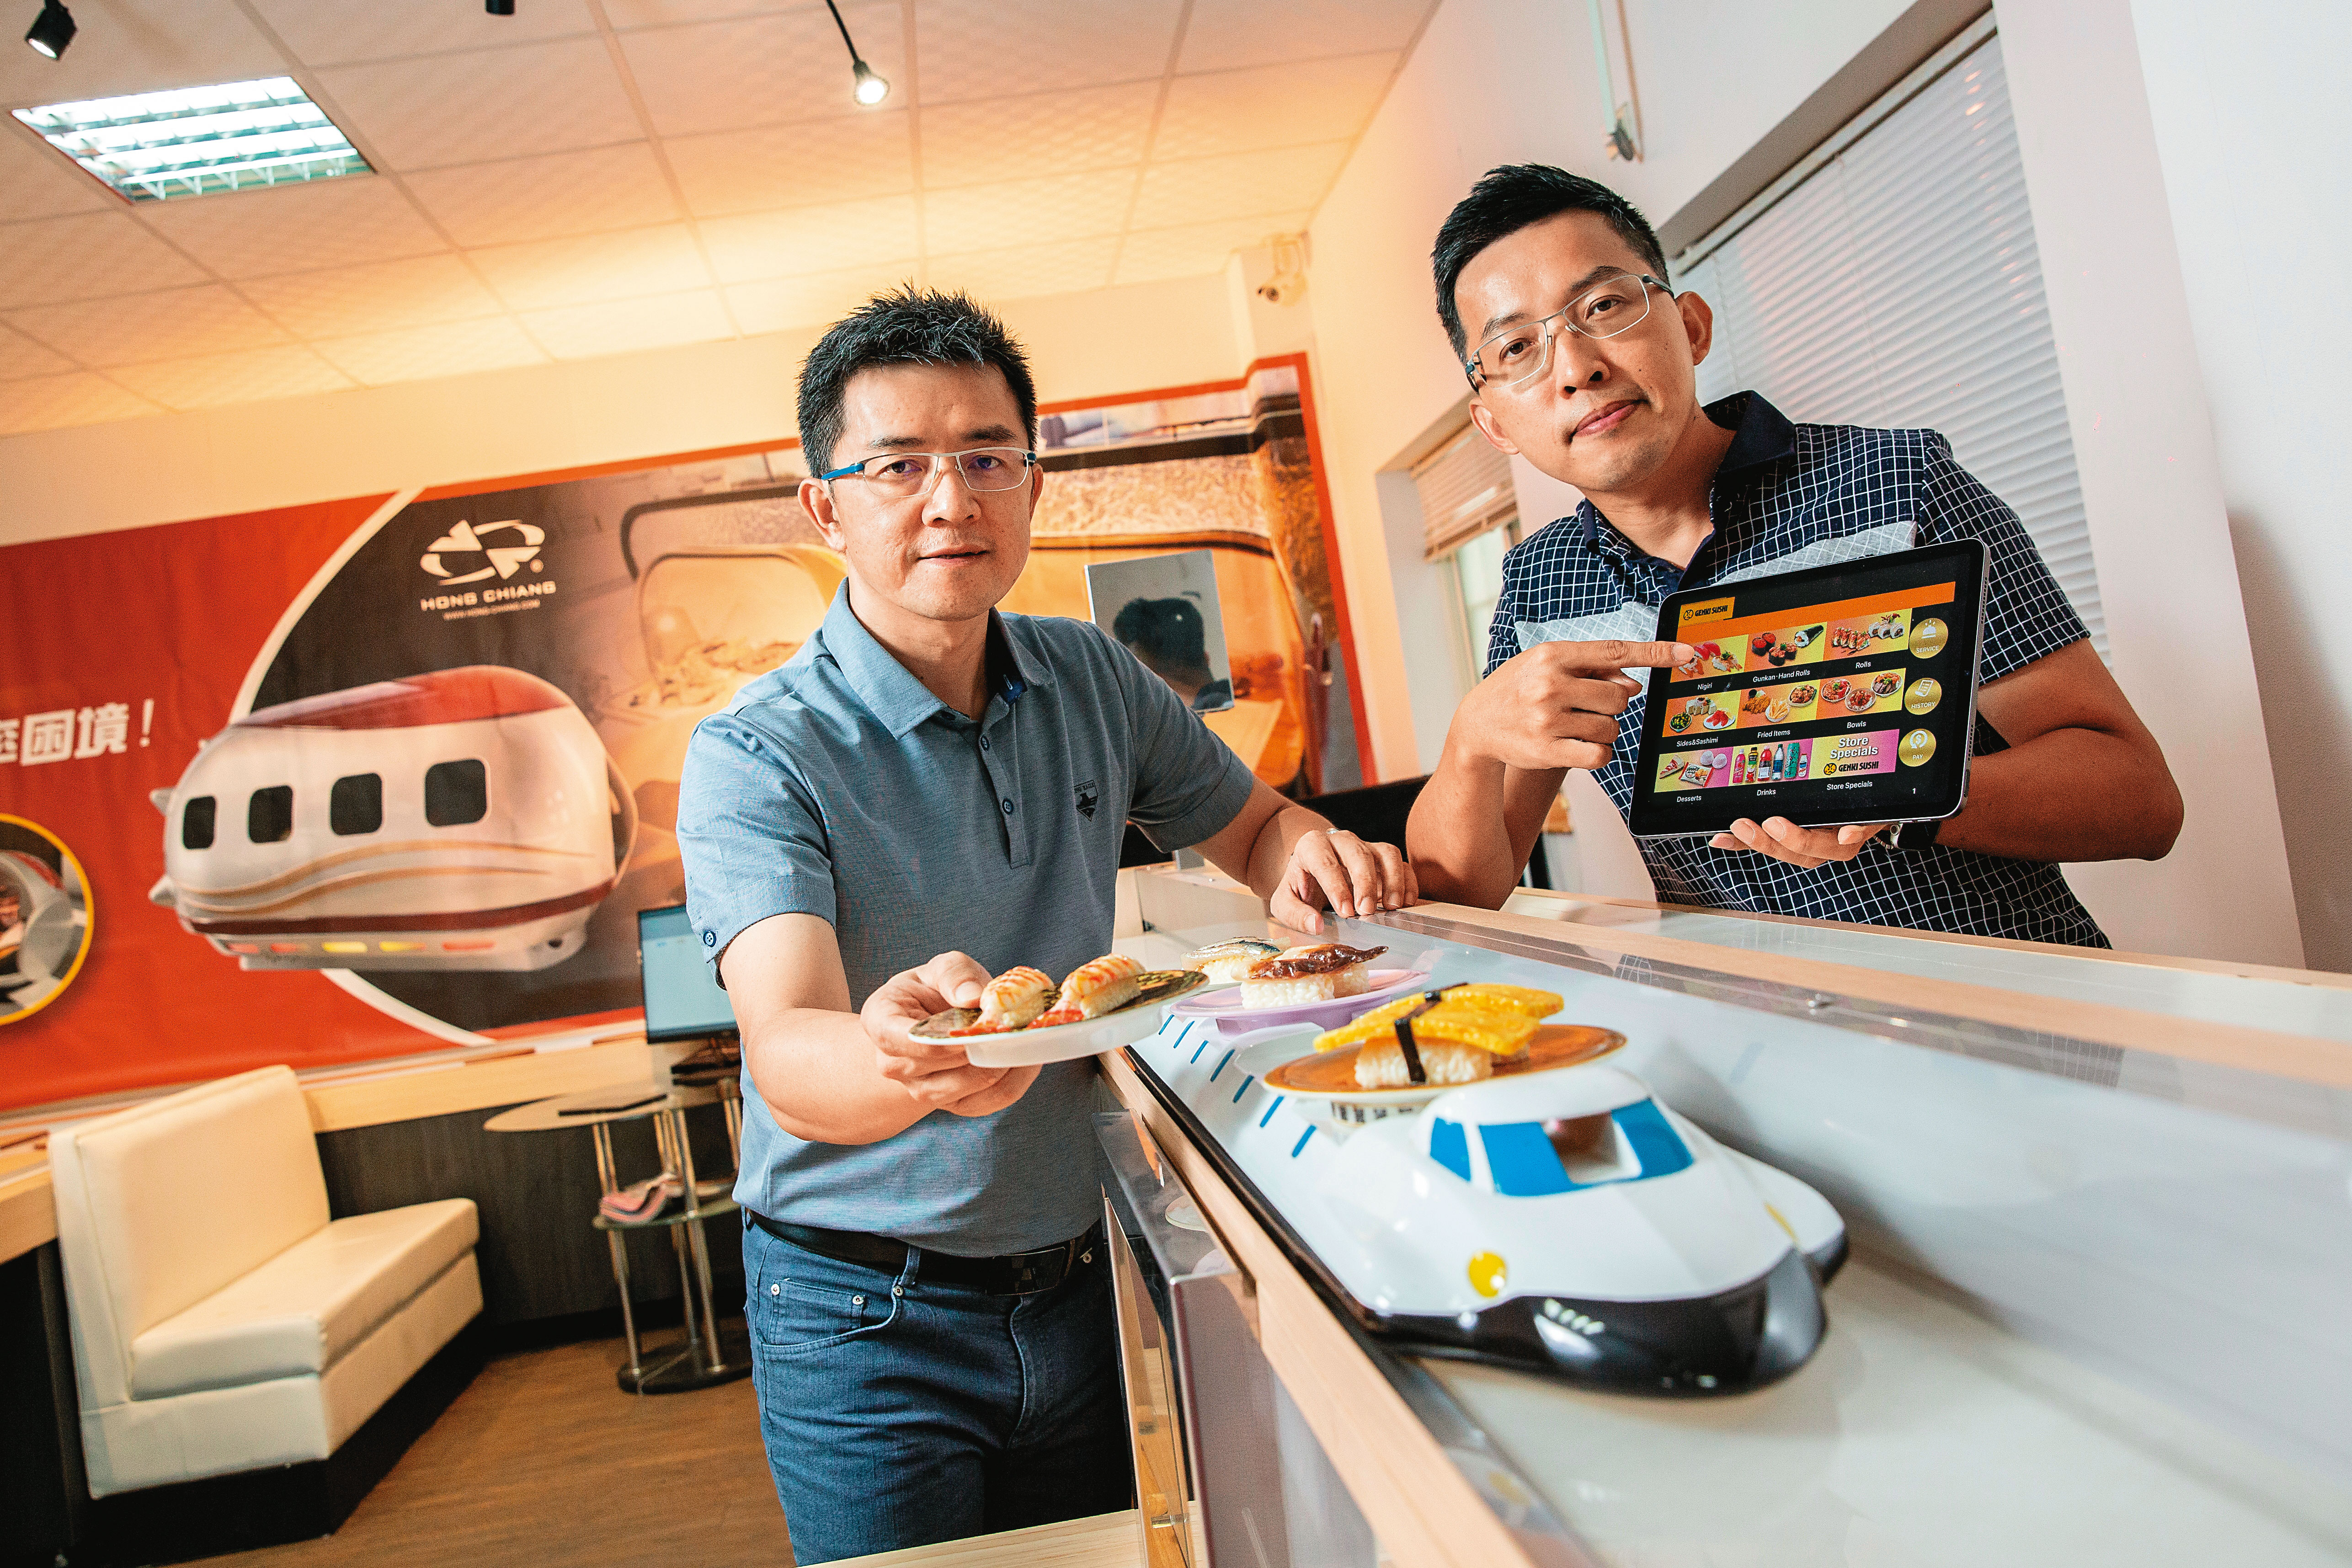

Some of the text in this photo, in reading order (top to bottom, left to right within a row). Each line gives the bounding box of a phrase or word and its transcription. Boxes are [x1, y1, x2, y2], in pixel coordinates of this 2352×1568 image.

[420, 592, 478, 612] HONG
[483, 581, 556, 603] CHIANG
[1695, 605, 1728, 616] GENKI SUSHI
[1916, 645, 1939, 654] SERVICE
[1697, 683, 1712, 691] Nigiri
[1676, 736, 1718, 747] Sides&Sashimi
[1838, 737, 1869, 748] Store
[1829, 746, 1878, 760] Specials
[1839, 761, 1879, 772] GENKI SUSHI
[1845, 781, 1872, 790] Specials
